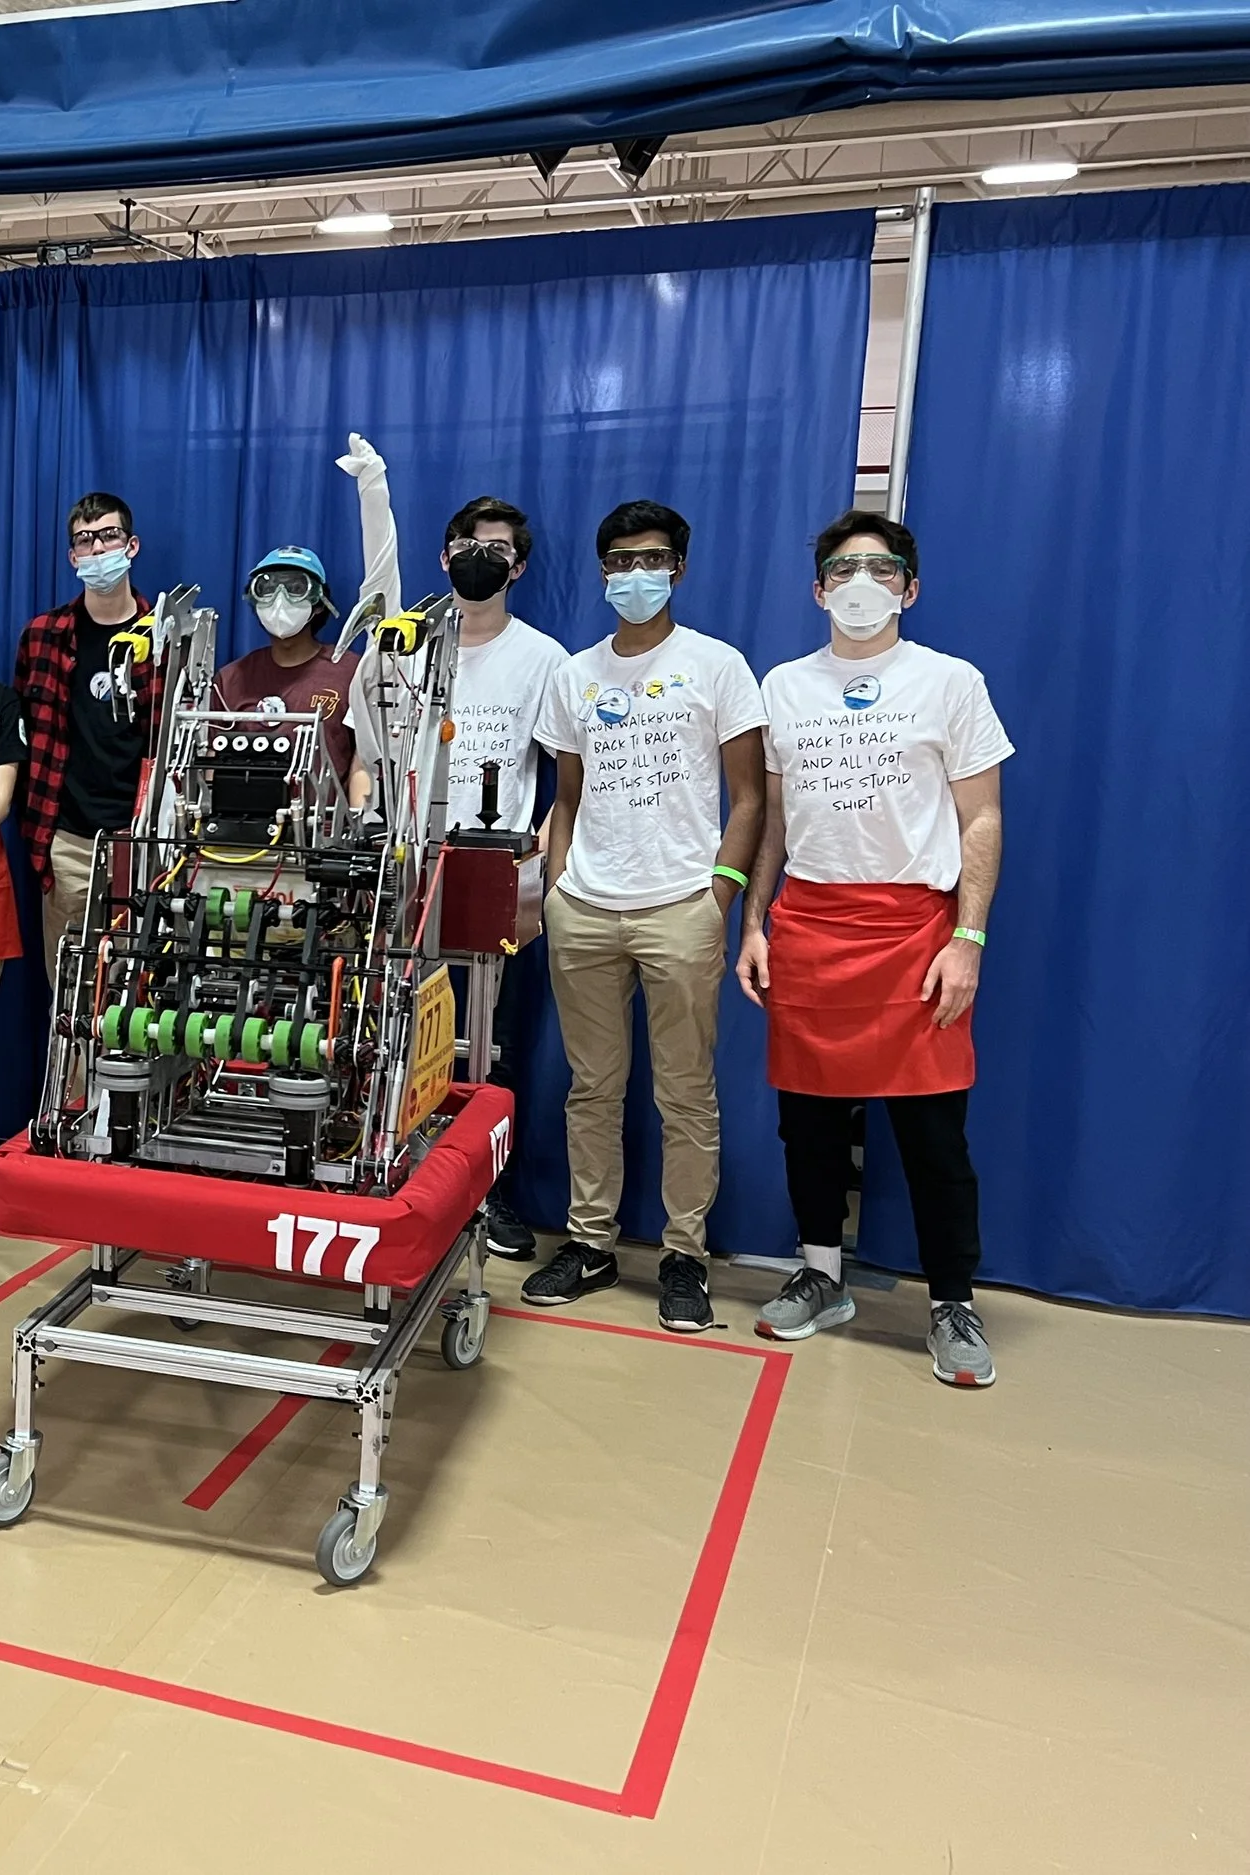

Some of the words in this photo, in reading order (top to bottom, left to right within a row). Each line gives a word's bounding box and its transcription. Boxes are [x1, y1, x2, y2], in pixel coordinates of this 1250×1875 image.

[310, 695, 340, 710] 177
[453, 705, 522, 717] WATERBURY
[461, 721, 472, 734] TO
[478, 722, 509, 733] BACK
[587, 722, 613, 733] WON
[619, 711, 692, 729] WATERBURY
[795, 717, 823, 729] WON
[828, 712, 917, 727] WATERBURY
[458, 740, 478, 751] ALL
[491, 738, 512, 751] GOT
[594, 739, 626, 754] BACK
[644, 731, 678, 745] BACK
[797, 736, 833, 751] BACK
[839, 733, 853, 748] TO
[859, 731, 899, 745] BACK
[474, 756, 516, 767] STPID
[598, 758, 627, 774] AND
[632, 754, 650, 768] ALL
[662, 749, 682, 765] GOT
[801, 757, 833, 771] AND
[839, 755, 863, 769] ALL
[877, 751, 904, 767] GOT
[448, 773, 484, 785] SHIRT
[590, 780, 616, 794] WAS
[647, 770, 691, 786] STUPID
[794, 780, 818, 792] WAS
[822, 776, 854, 792] THIS
[859, 773, 911, 789] STUPID
[629, 791, 662, 808] SHIRT
[832, 795, 876, 811] SHIRT
[418, 1001, 442, 1060] 177
[267, 1213, 380, 1283] 177
